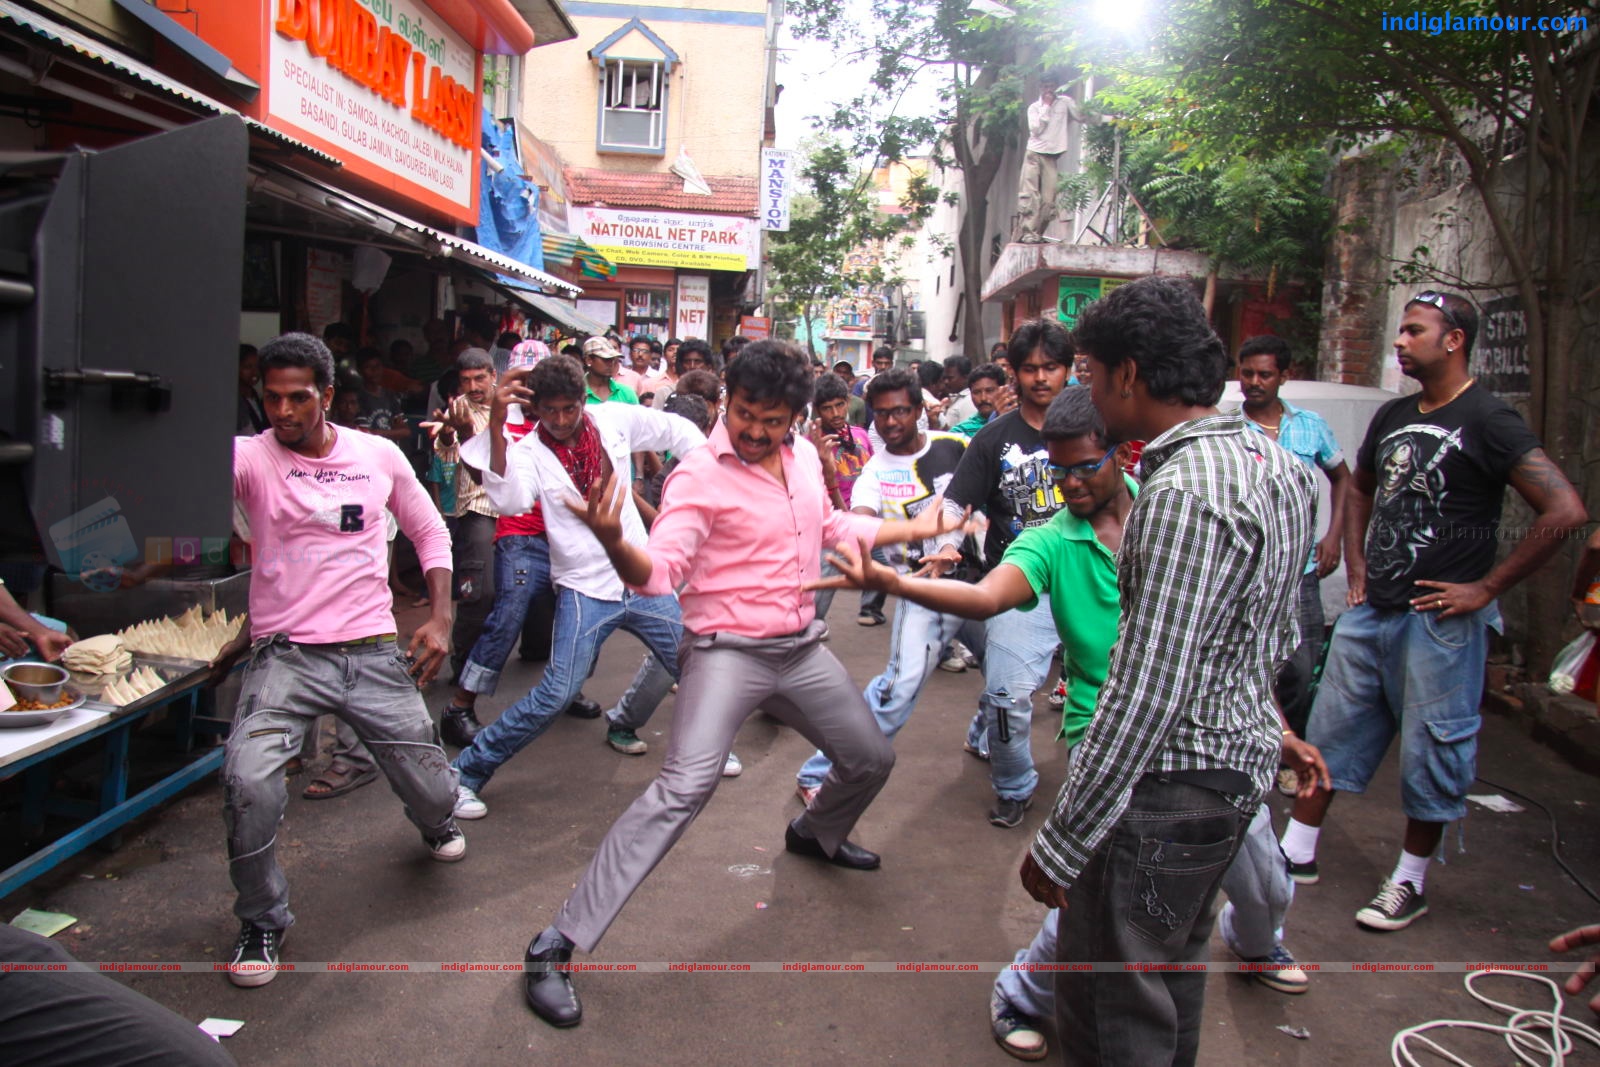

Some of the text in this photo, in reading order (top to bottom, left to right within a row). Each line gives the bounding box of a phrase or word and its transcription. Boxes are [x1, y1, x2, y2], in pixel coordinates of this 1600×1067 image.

[284, 59, 334, 103] SPECIALIST
[335, 90, 347, 111] IN:
[411, 51, 476, 152] LASSI
[300, 97, 340, 136] BASANDI,
[341, 121, 367, 147] GULAB
[394, 148, 427, 177] SAVOURIES
[766, 158, 786, 229] MANSION
[591, 222, 738, 245] NATIONAL NET PARK
[623, 239, 705, 252] BROWSING CENTRE
[680, 308, 706, 324] NET
[1487, 310, 1528, 341] STICK
